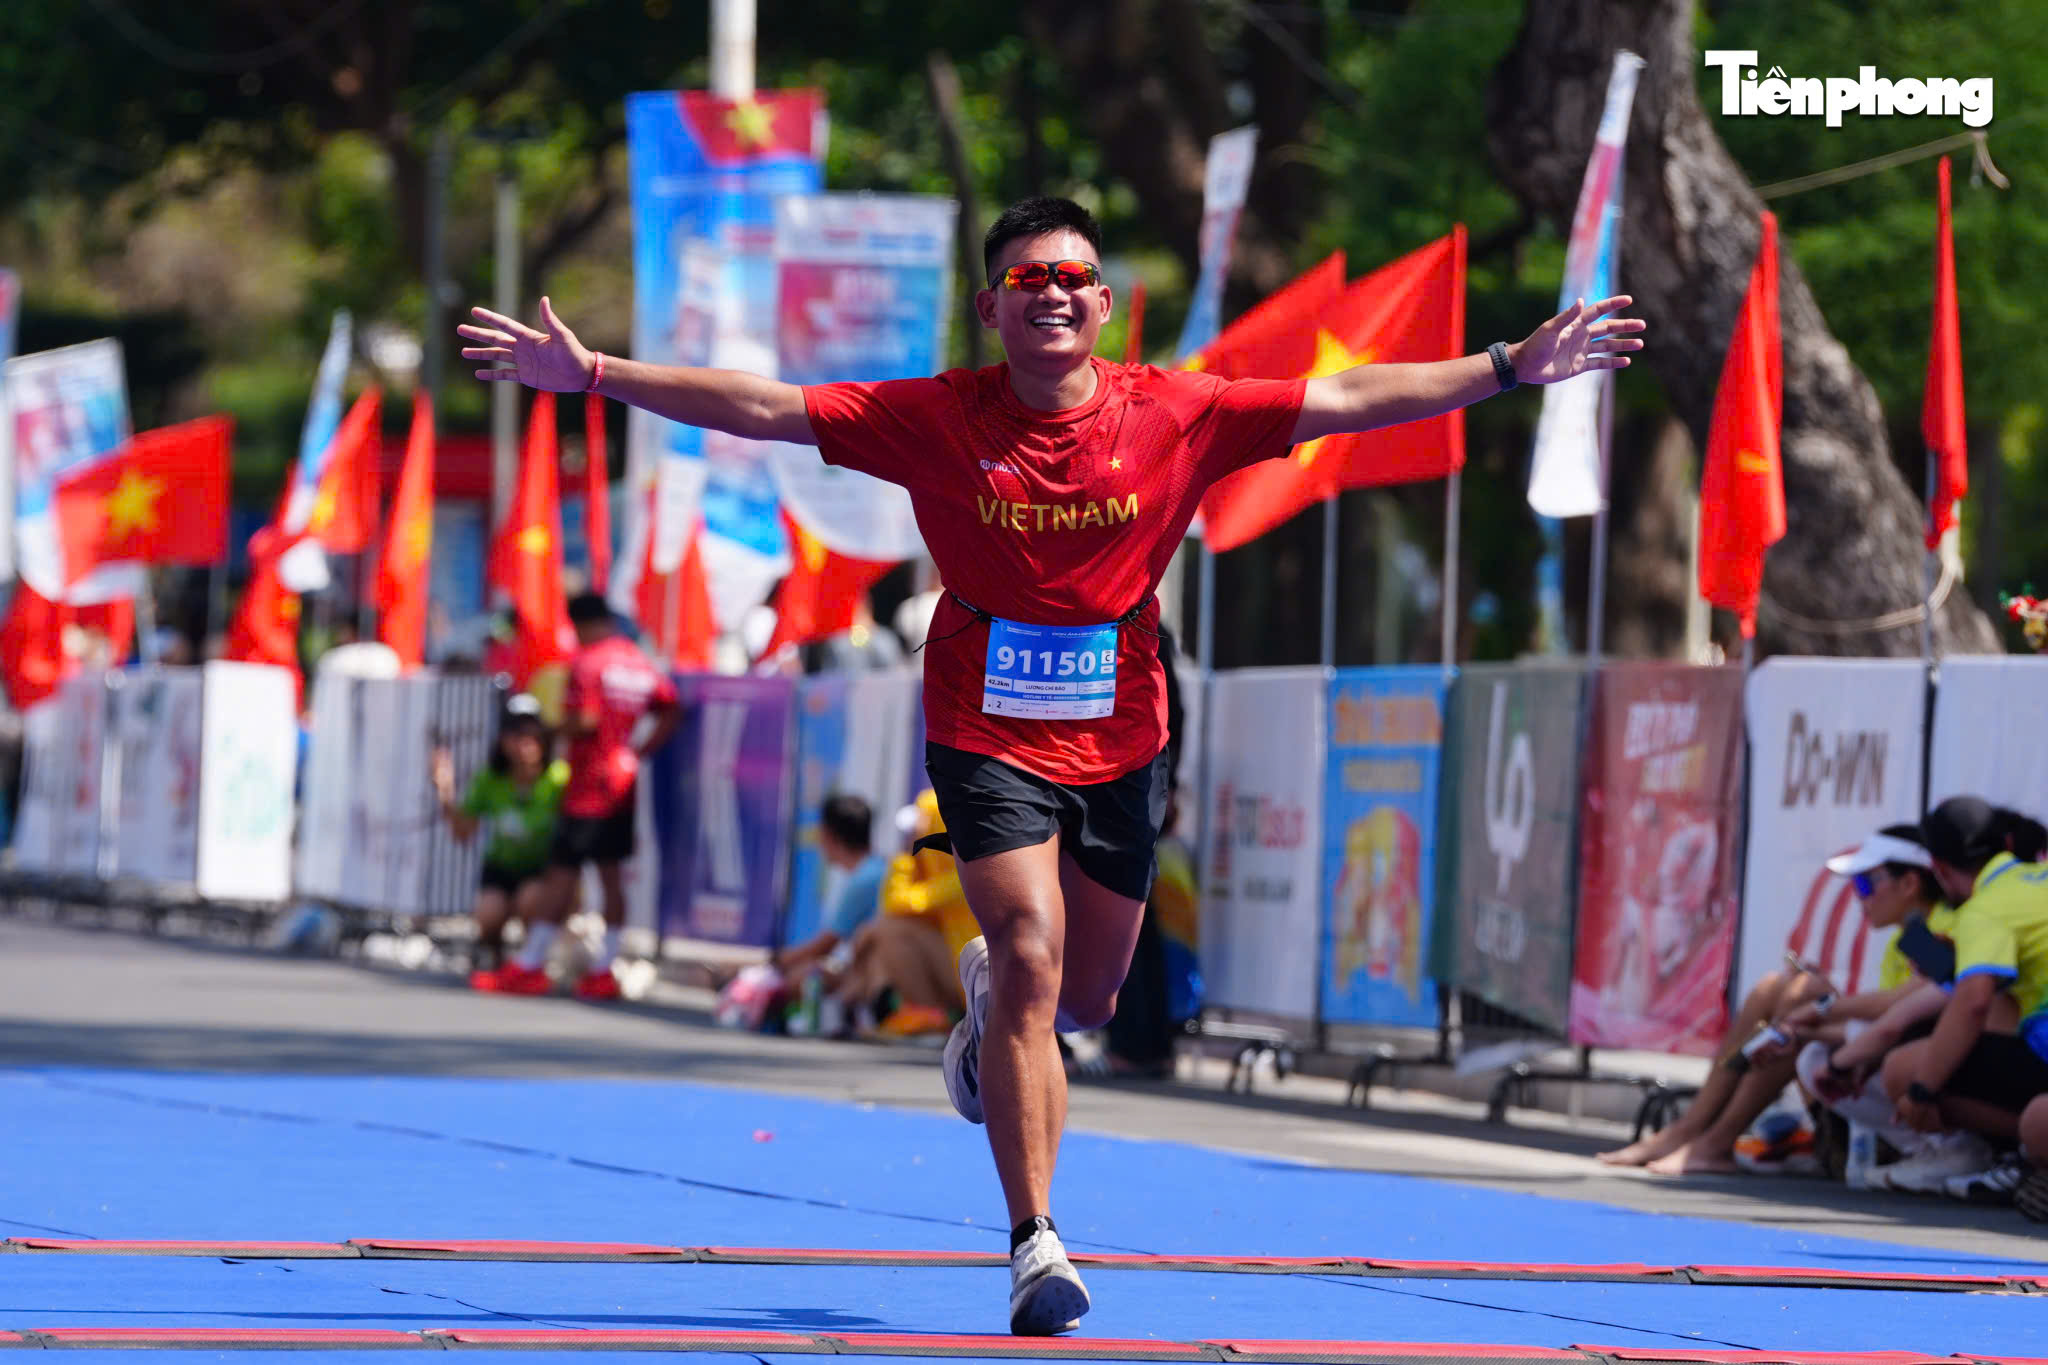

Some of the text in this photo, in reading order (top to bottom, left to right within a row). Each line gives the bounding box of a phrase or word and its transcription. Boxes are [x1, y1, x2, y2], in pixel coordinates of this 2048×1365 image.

[977, 493, 1139, 532] VIETNAM
[996, 645, 1097, 676] 91150
[1105, 654, 1111, 662] C
[988, 678, 1010, 688] 42,2km
[996, 700, 1002, 709] 2
